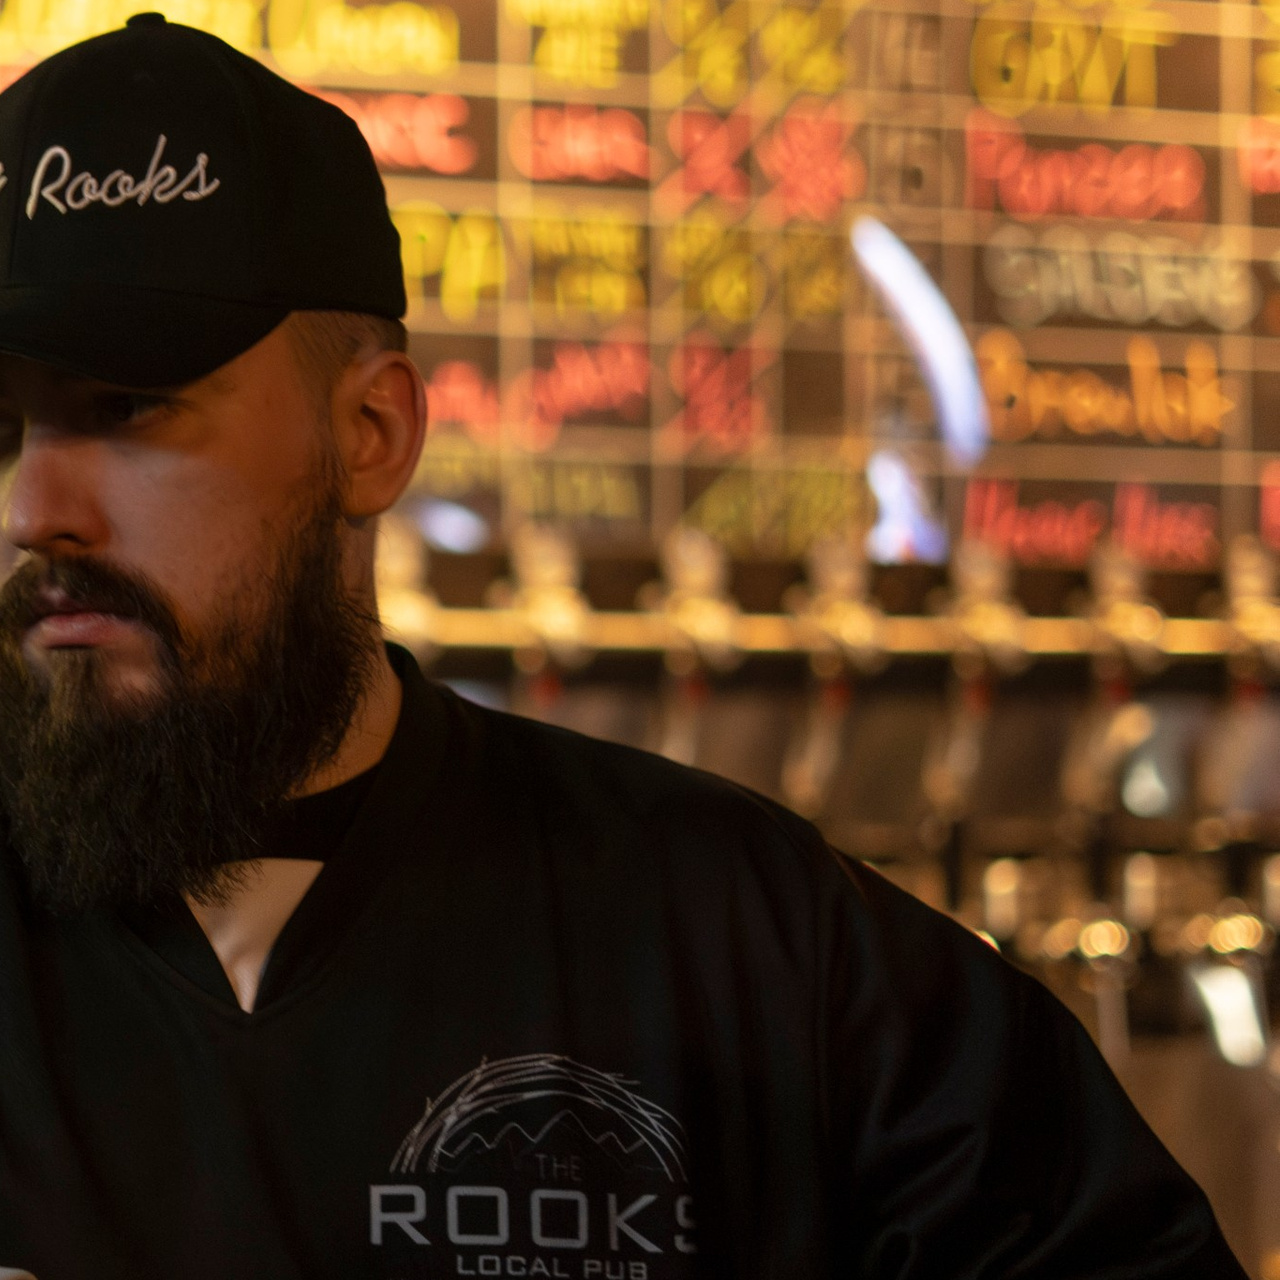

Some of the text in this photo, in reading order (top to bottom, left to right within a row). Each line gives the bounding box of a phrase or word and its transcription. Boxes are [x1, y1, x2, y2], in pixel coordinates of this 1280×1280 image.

[25, 132, 221, 221] Rooks
[534, 1152, 583, 1183] THE
[456, 1254, 571, 1279] LOCAL
